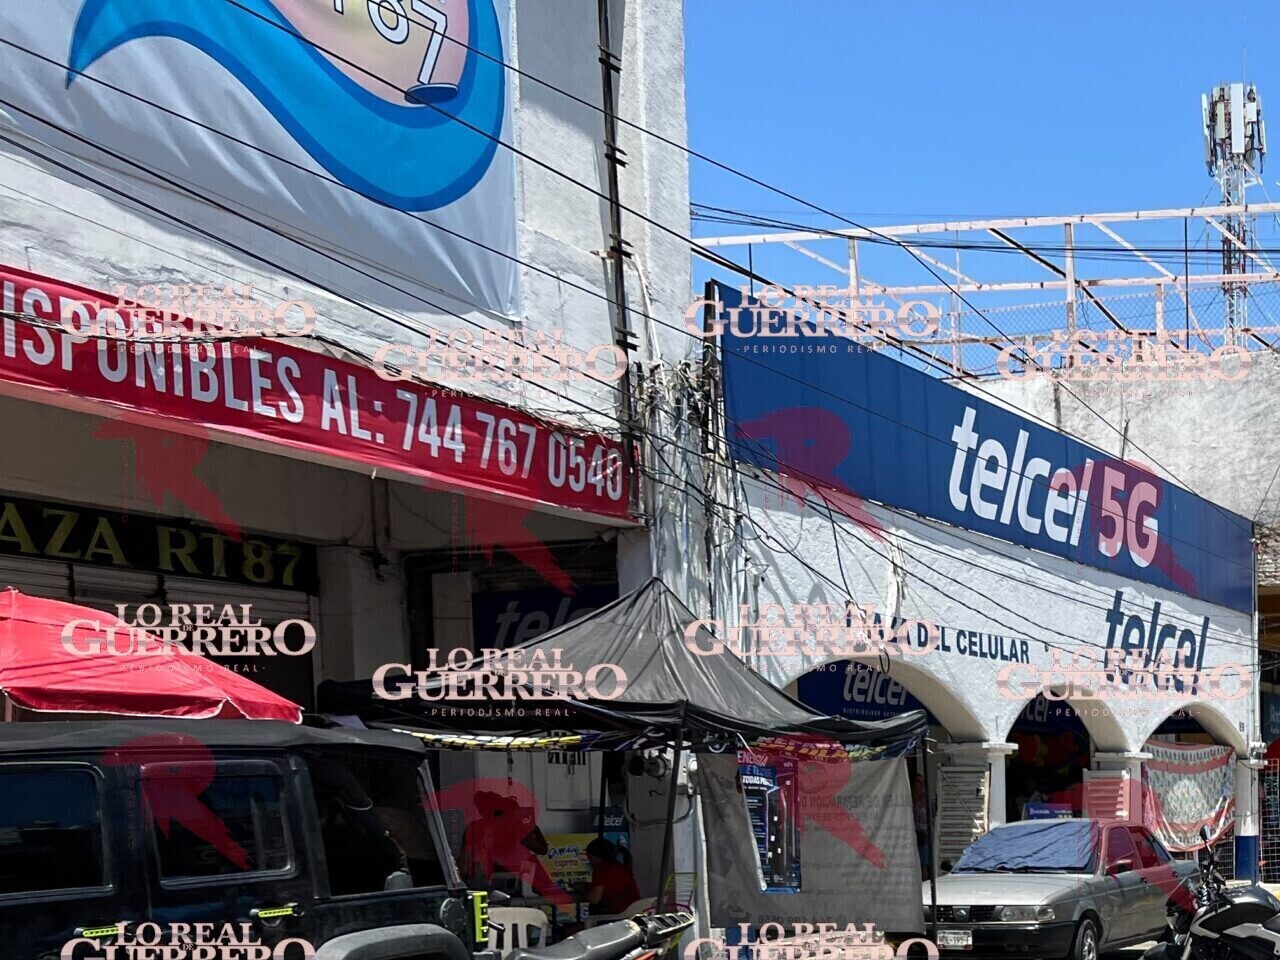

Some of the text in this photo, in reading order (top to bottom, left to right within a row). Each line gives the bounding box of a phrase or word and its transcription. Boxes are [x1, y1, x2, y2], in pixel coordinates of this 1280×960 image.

[320, 368, 385, 445] AL:
[397, 388, 466, 464] 744
[475, 410, 537, 479] 767
[548, 430, 623, 500] 0540
[948, 406, 1159, 568] telcel 5G
[843, 667, 907, 706] telcel
[956, 629, 1030, 664] CELULAR
[1104, 589, 1210, 697] telcel
